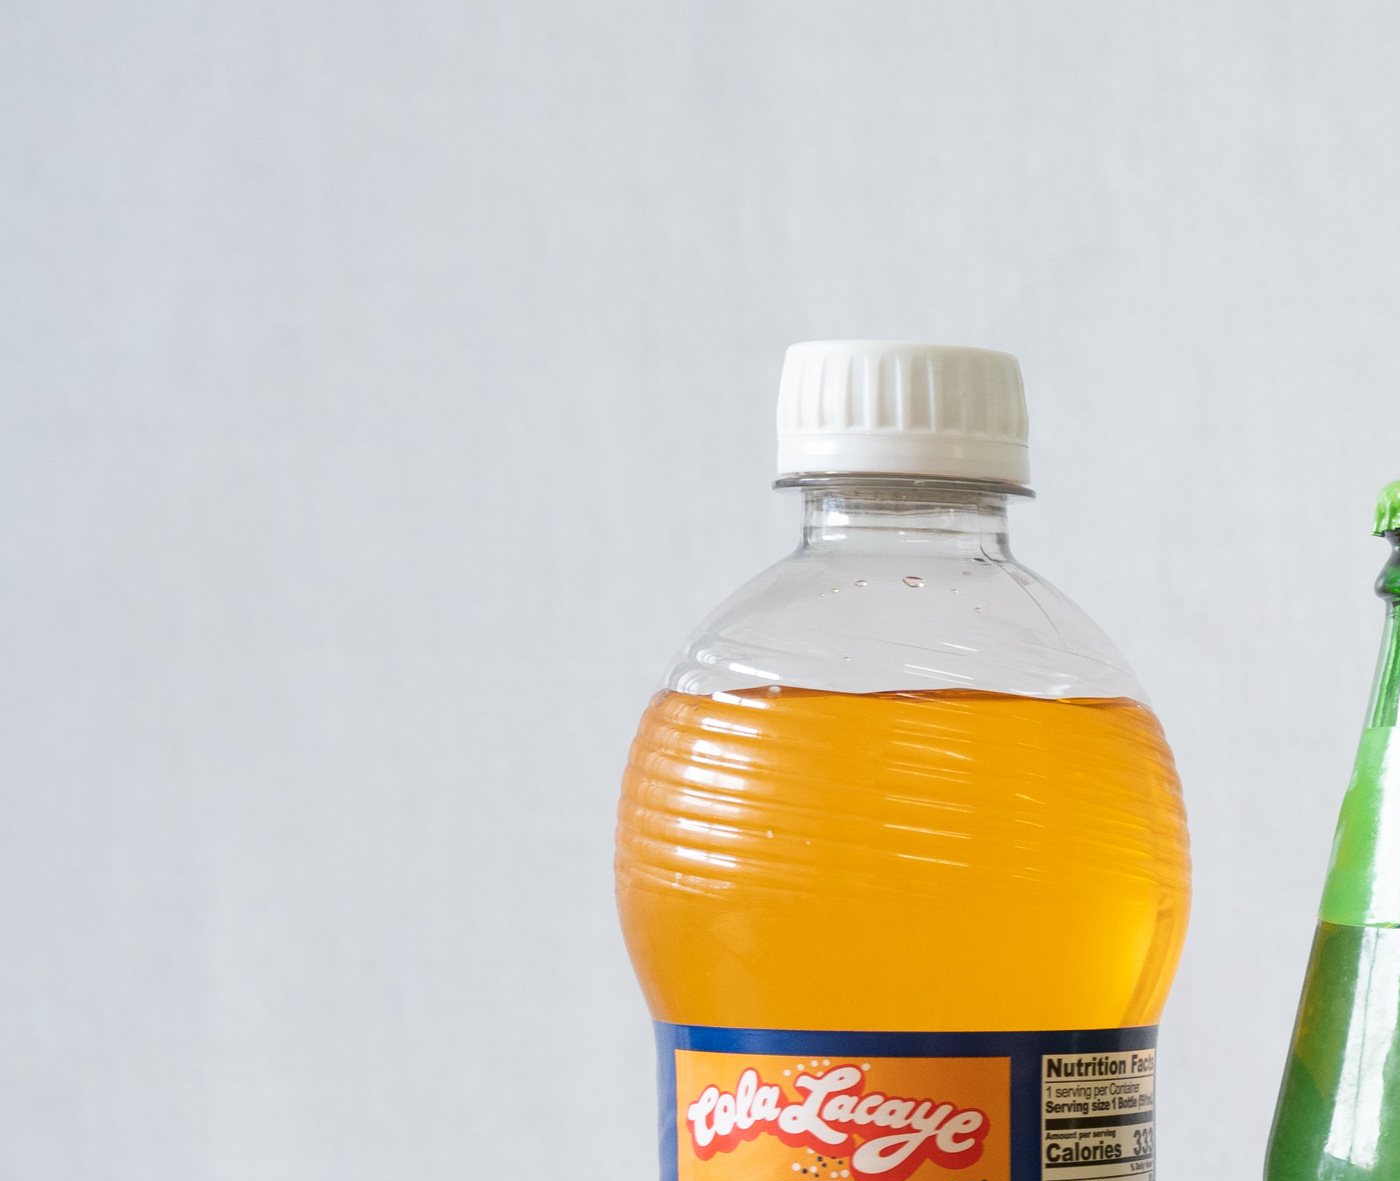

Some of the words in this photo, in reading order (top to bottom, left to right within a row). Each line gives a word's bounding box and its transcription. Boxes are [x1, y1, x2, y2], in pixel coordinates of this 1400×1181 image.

[1046, 1056, 1127, 1078] Nutrition
[1045, 1086, 1052, 1099] 1
[1055, 1084, 1092, 1100] serving
[1093, 1085, 1109, 1099] per
[1109, 1081, 1141, 1096] Container
[1045, 1100, 1090, 1115] Serving
[1091, 1098, 1110, 1111] size
[1118, 1096, 1138, 1110] Bottle
[687, 1069, 782, 1148] Cola
[778, 1066, 984, 1176] Lacaye
[1045, 1132, 1077, 1141] Amount
[1078, 1131, 1091, 1140] per
[1092, 1129, 1116, 1139] serving
[1046, 1140, 1122, 1163] Calories
